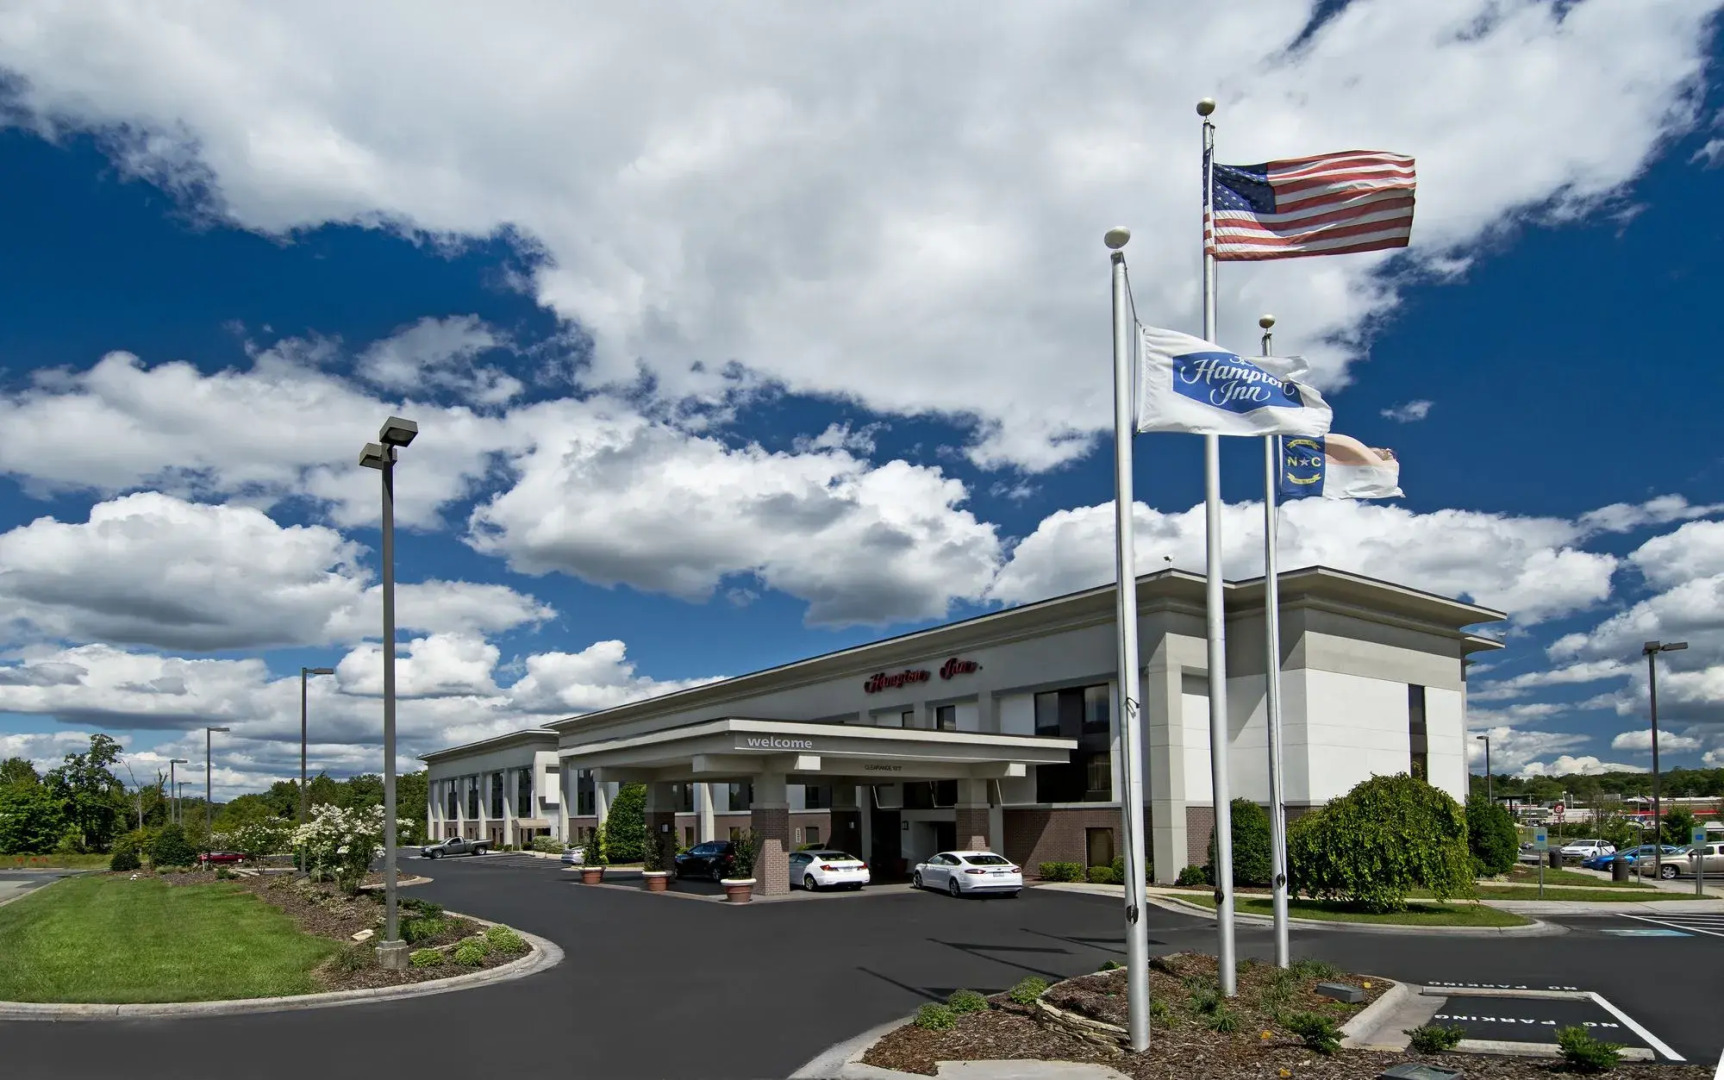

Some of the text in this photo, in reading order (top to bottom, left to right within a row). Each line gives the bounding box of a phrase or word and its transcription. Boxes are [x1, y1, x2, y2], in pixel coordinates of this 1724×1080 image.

[1180, 358, 1295, 396] Hampton
[1209, 380, 1272, 406] Inn
[1287, 456, 1322, 467] N C
[864, 657, 979, 694] Hampton Inn
[747, 736, 813, 749] welcome
[1428, 981, 1527, 989] PARKING
[1434, 1014, 1556, 1025] PARKING
